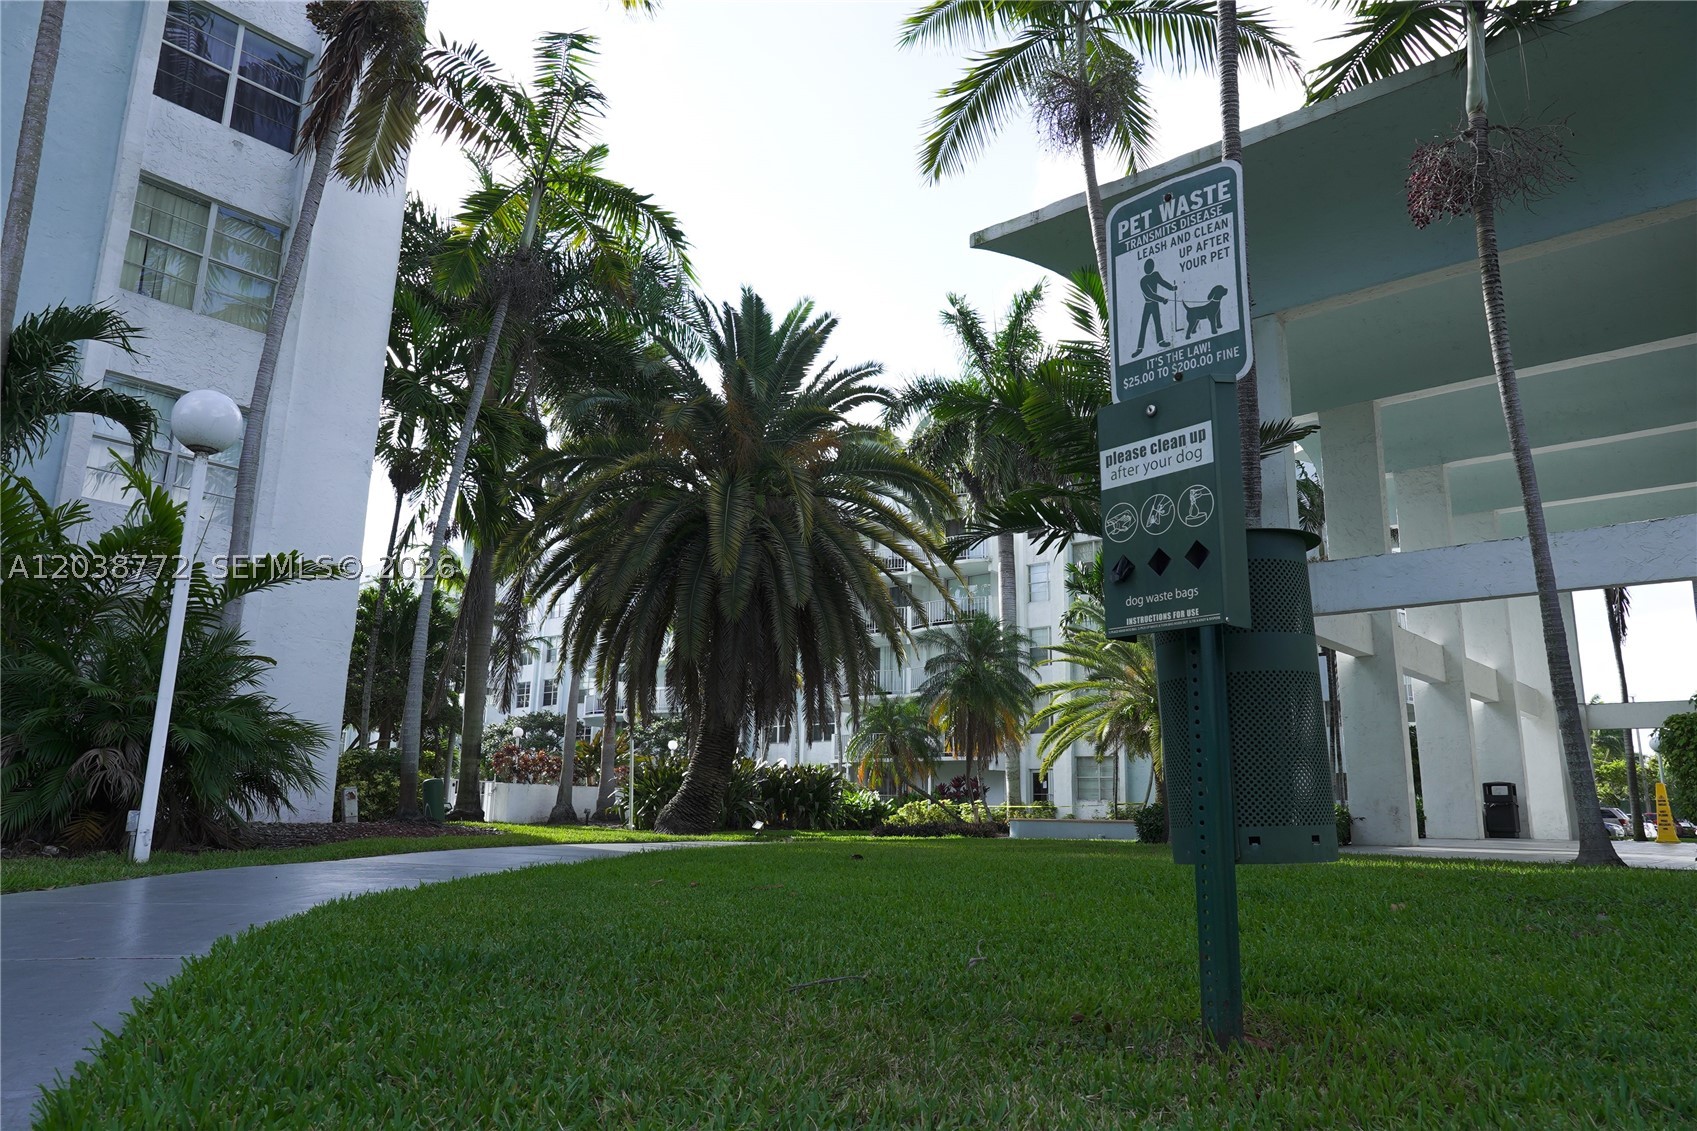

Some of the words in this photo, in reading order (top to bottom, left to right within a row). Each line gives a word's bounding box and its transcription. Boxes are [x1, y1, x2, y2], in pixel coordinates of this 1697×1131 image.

[1118, 209, 1153, 241] PET
[1158, 179, 1231, 223] WASTE
[1125, 222, 1177, 251] TRANSMITS
[1180, 205, 1223, 230] DISEASE
[1137, 240, 1167, 261] LEASH
[1170, 231, 1191, 248] AND
[1194, 217, 1229, 239] CLEAN
[1179, 245, 1193, 259] UP
[1196, 232, 1230, 253] AFTER
[1179, 254, 1207, 273] YOUR
[1210, 246, 1230, 263] PET
[1123, 370, 1155, 390] $25.00
[1157, 366, 1169, 378] TO
[1171, 353, 1214, 375] $200.00
[1216, 345, 1240, 362] FINE
[1146, 355, 1164, 370] IT'S
[1166, 349, 1185, 363] THE
[1187, 341, 1212, 358] LAW!
[1105, 445, 1147, 469] please
[1150, 434, 1187, 455] clean
[1189, 428, 1207, 444] up
[1110, 465, 1140, 481] after
[1142, 455, 1173, 476] your
[1175, 447, 1203, 464] dog
[1125, 595, 1144, 608] dog
[1145, 591, 1174, 604] waste
[1175, 587, 1199, 600] bags
[1126, 612, 1172, 626] INSTRUCTIONS
[1172, 610, 1186, 619] FOR
[1186, 608, 1200, 617] USE
